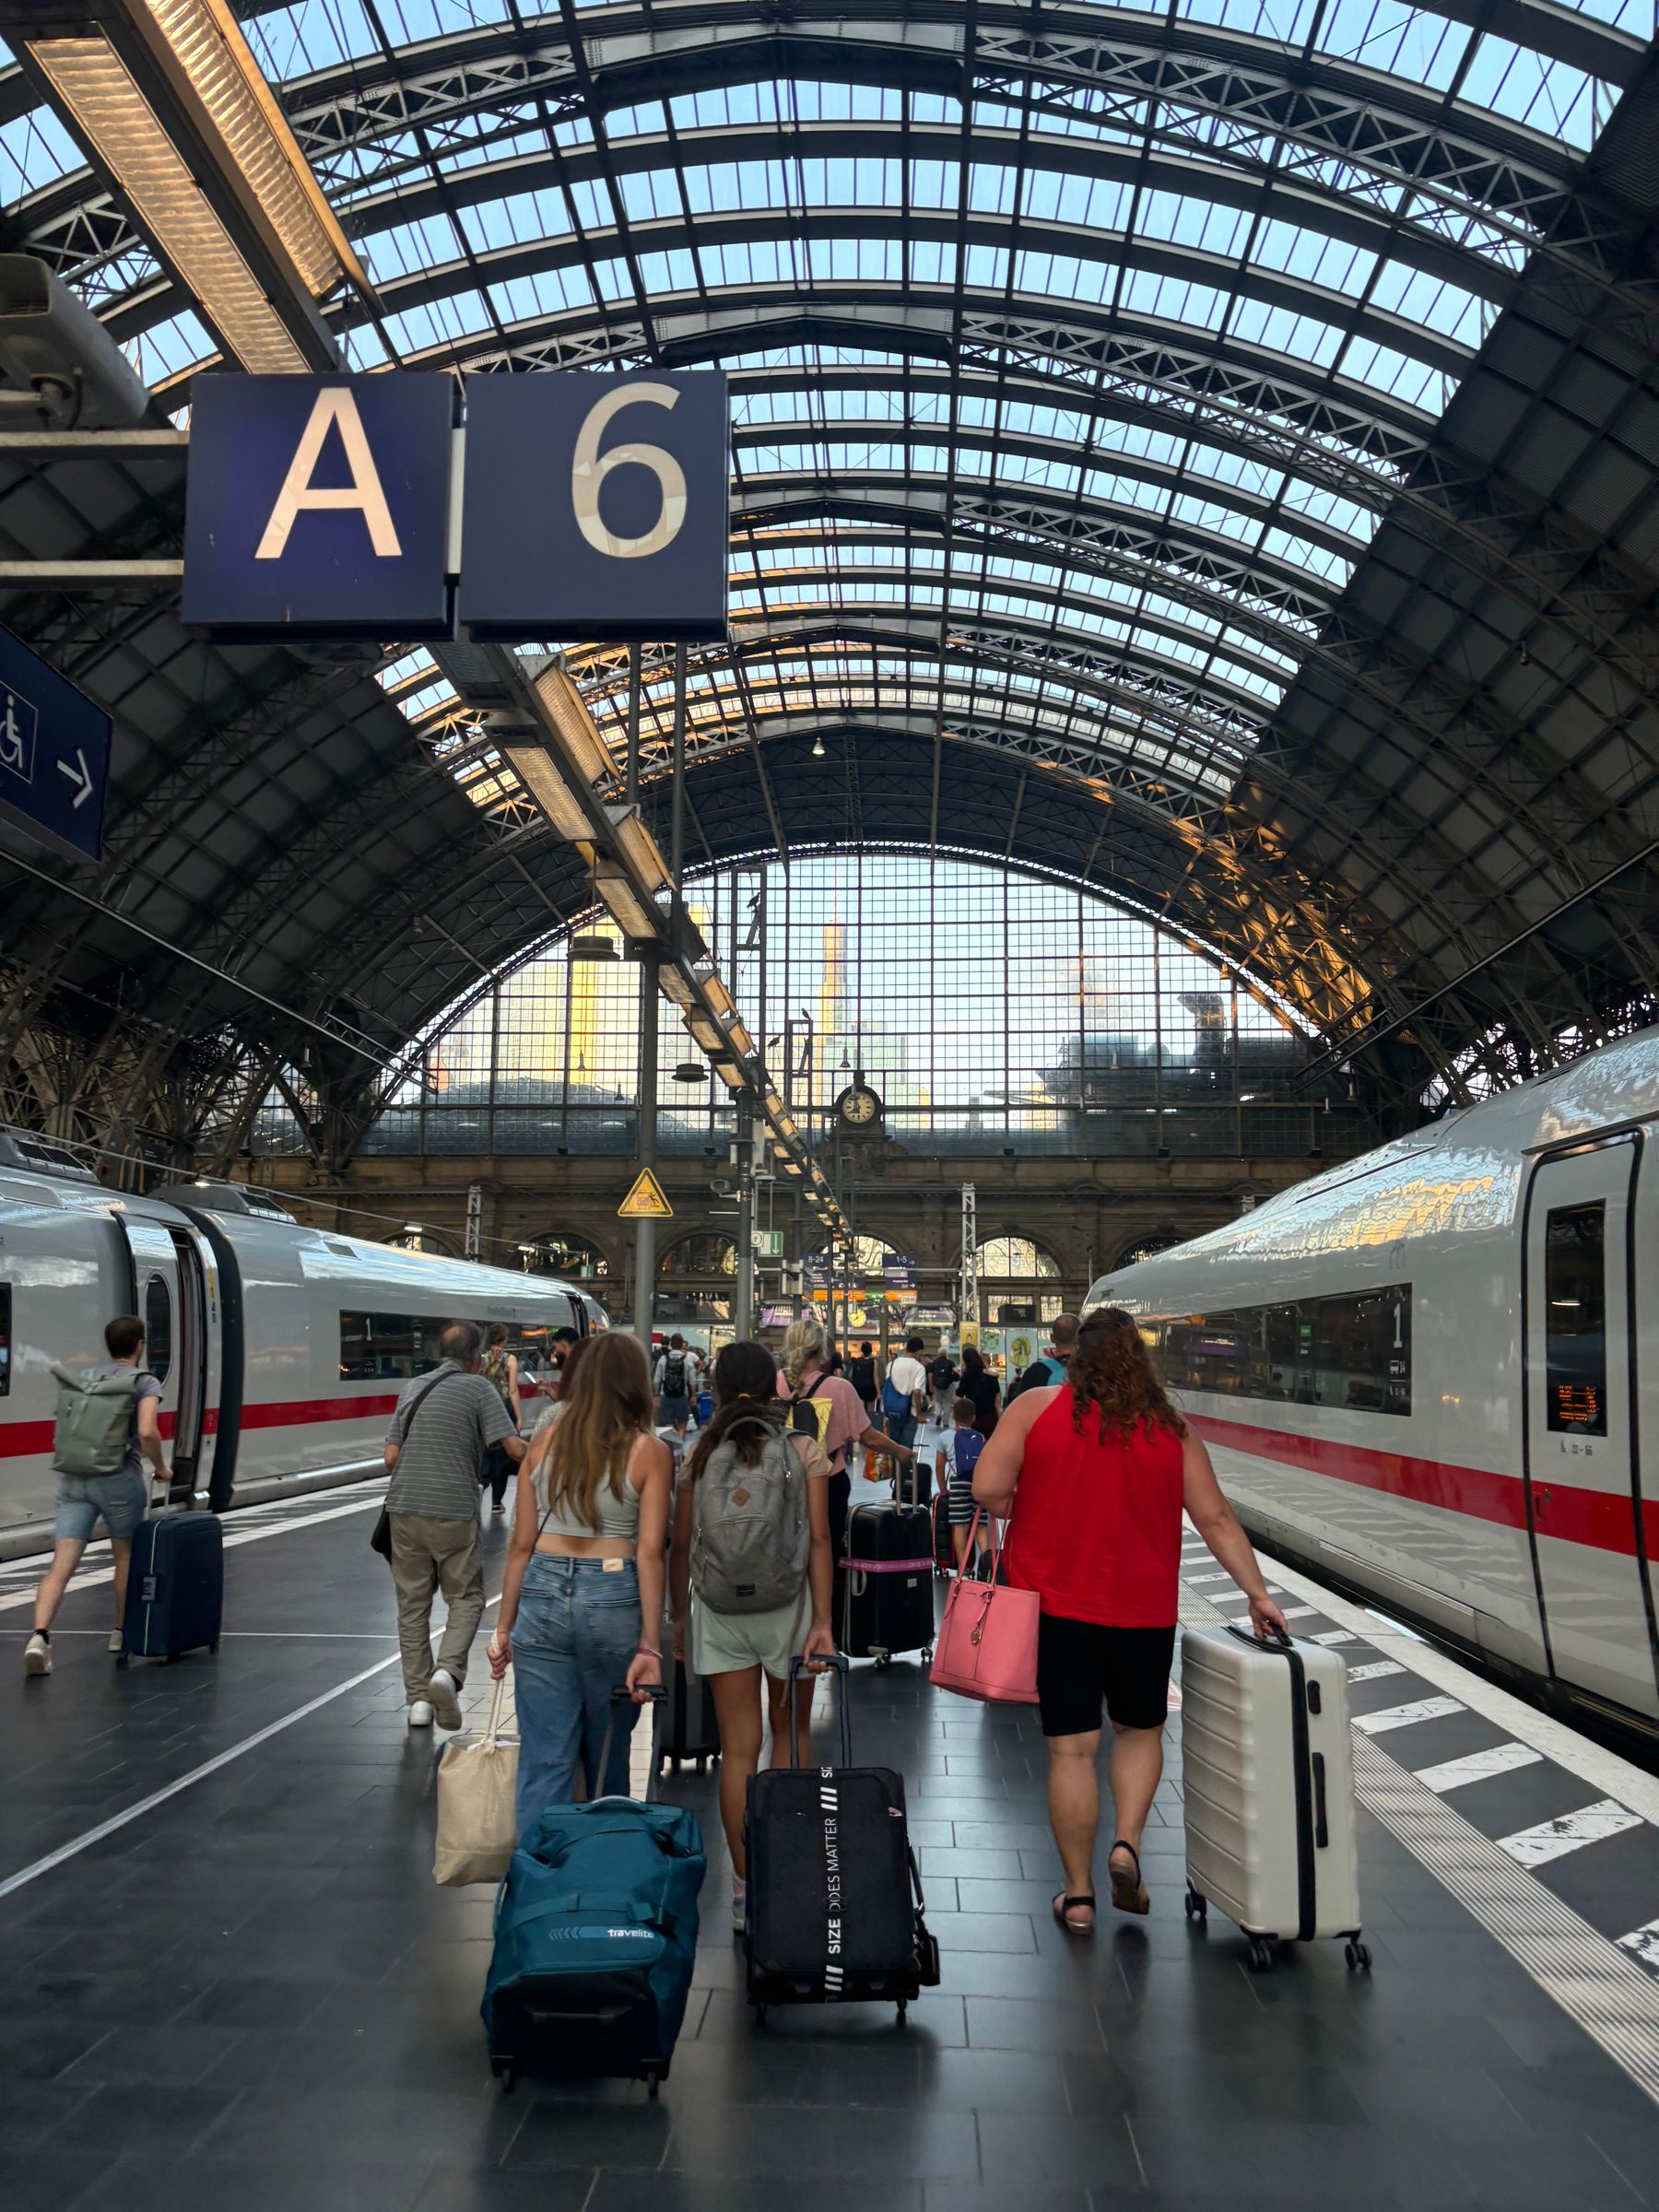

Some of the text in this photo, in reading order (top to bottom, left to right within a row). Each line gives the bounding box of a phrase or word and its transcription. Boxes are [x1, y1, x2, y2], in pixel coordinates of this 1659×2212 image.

[254, 382, 688, 559] A 6
[896, 1255, 908, 1264] 1-5
[365, 1317, 372, 1341] 1
[1394, 1303, 1403, 1348] 1
[825, 1818, 841, 1955] SIZE DOES MATTER
[607, 1928, 654, 1939] travelite
